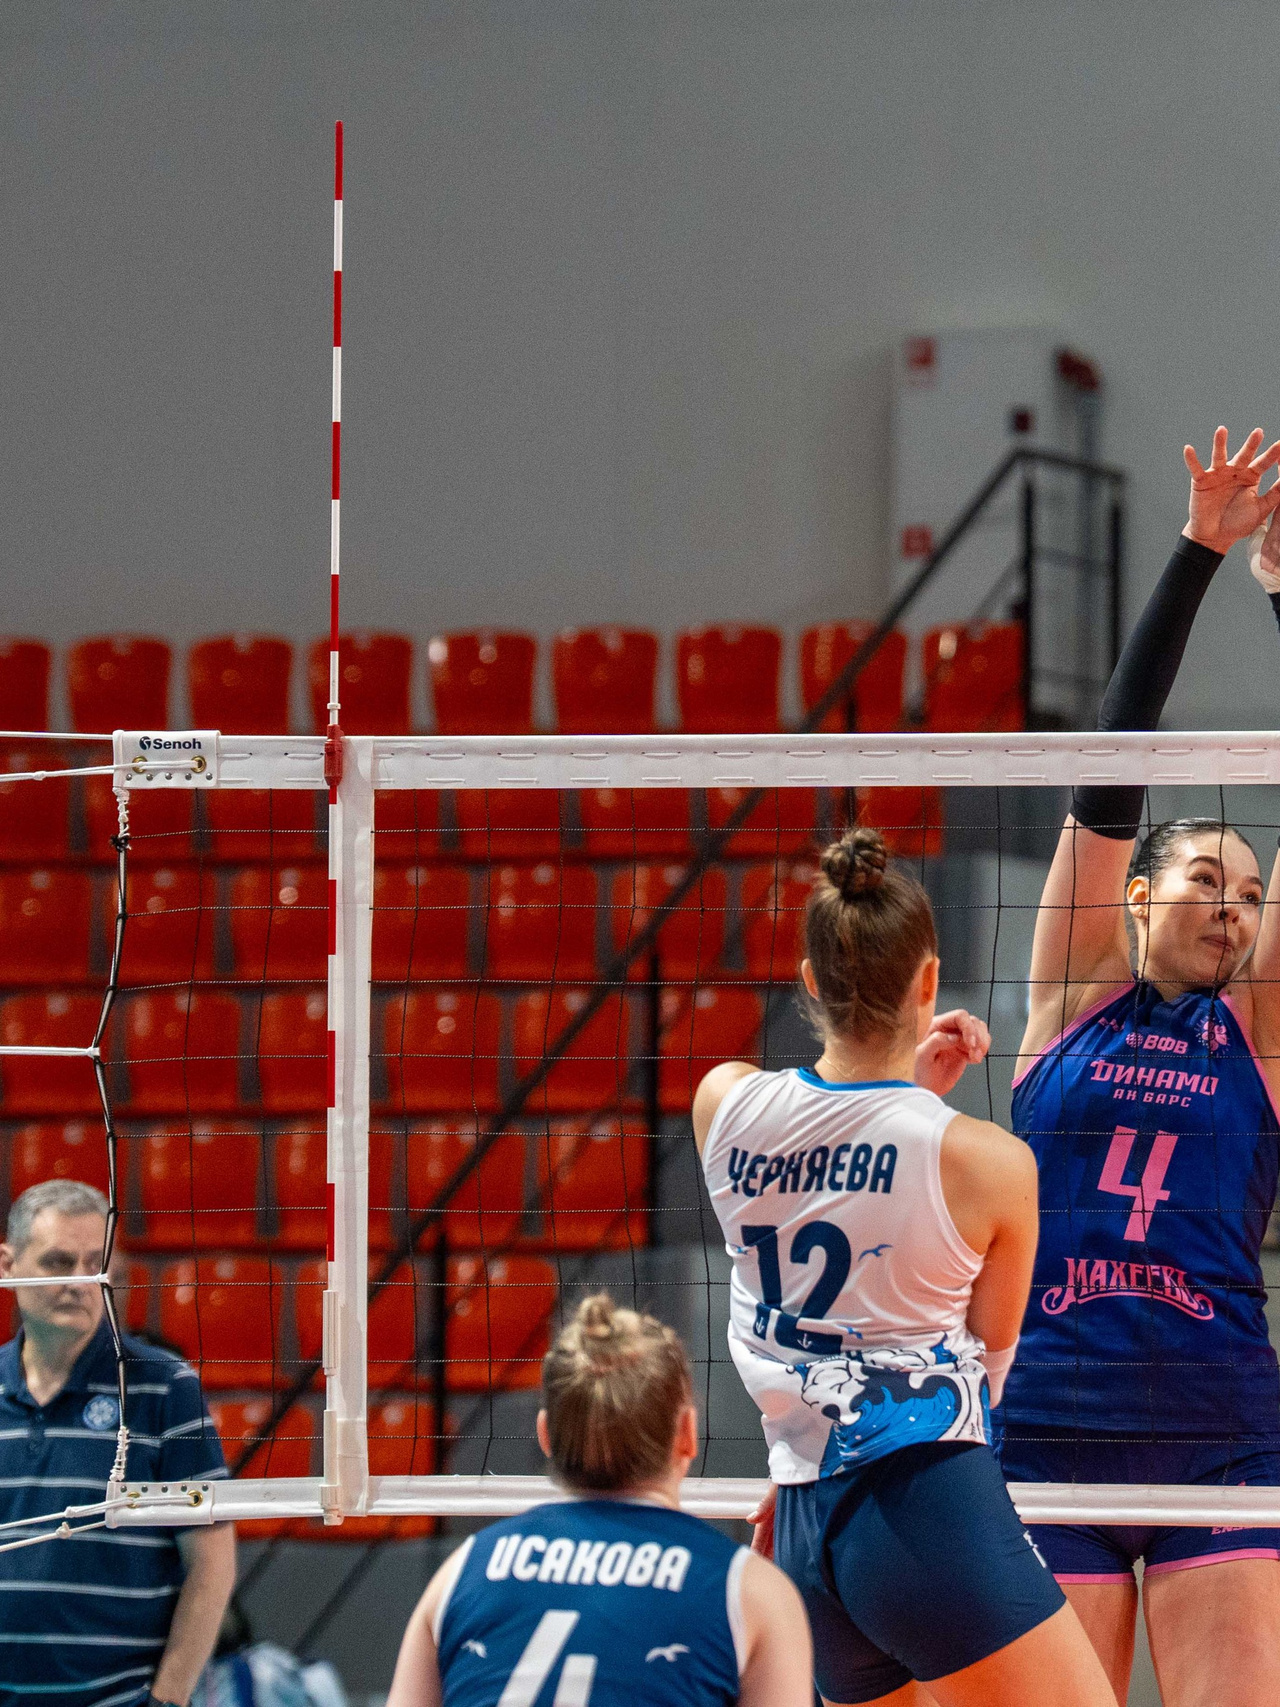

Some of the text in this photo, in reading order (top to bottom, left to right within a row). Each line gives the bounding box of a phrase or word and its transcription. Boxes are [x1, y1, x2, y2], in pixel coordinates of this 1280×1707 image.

[153, 738, 202, 750] Senoh
[1143, 1034, 1189, 1055] ВФВ
[1090, 1059, 1219, 1097] ДИНАМО
[1113, 1088, 1192, 1108] АК БАРС
[728, 1143, 898, 1198] ЧЕРНЯЕВА
[1097, 1125, 1179, 1243] 4
[741, 1220, 851, 1355] 12
